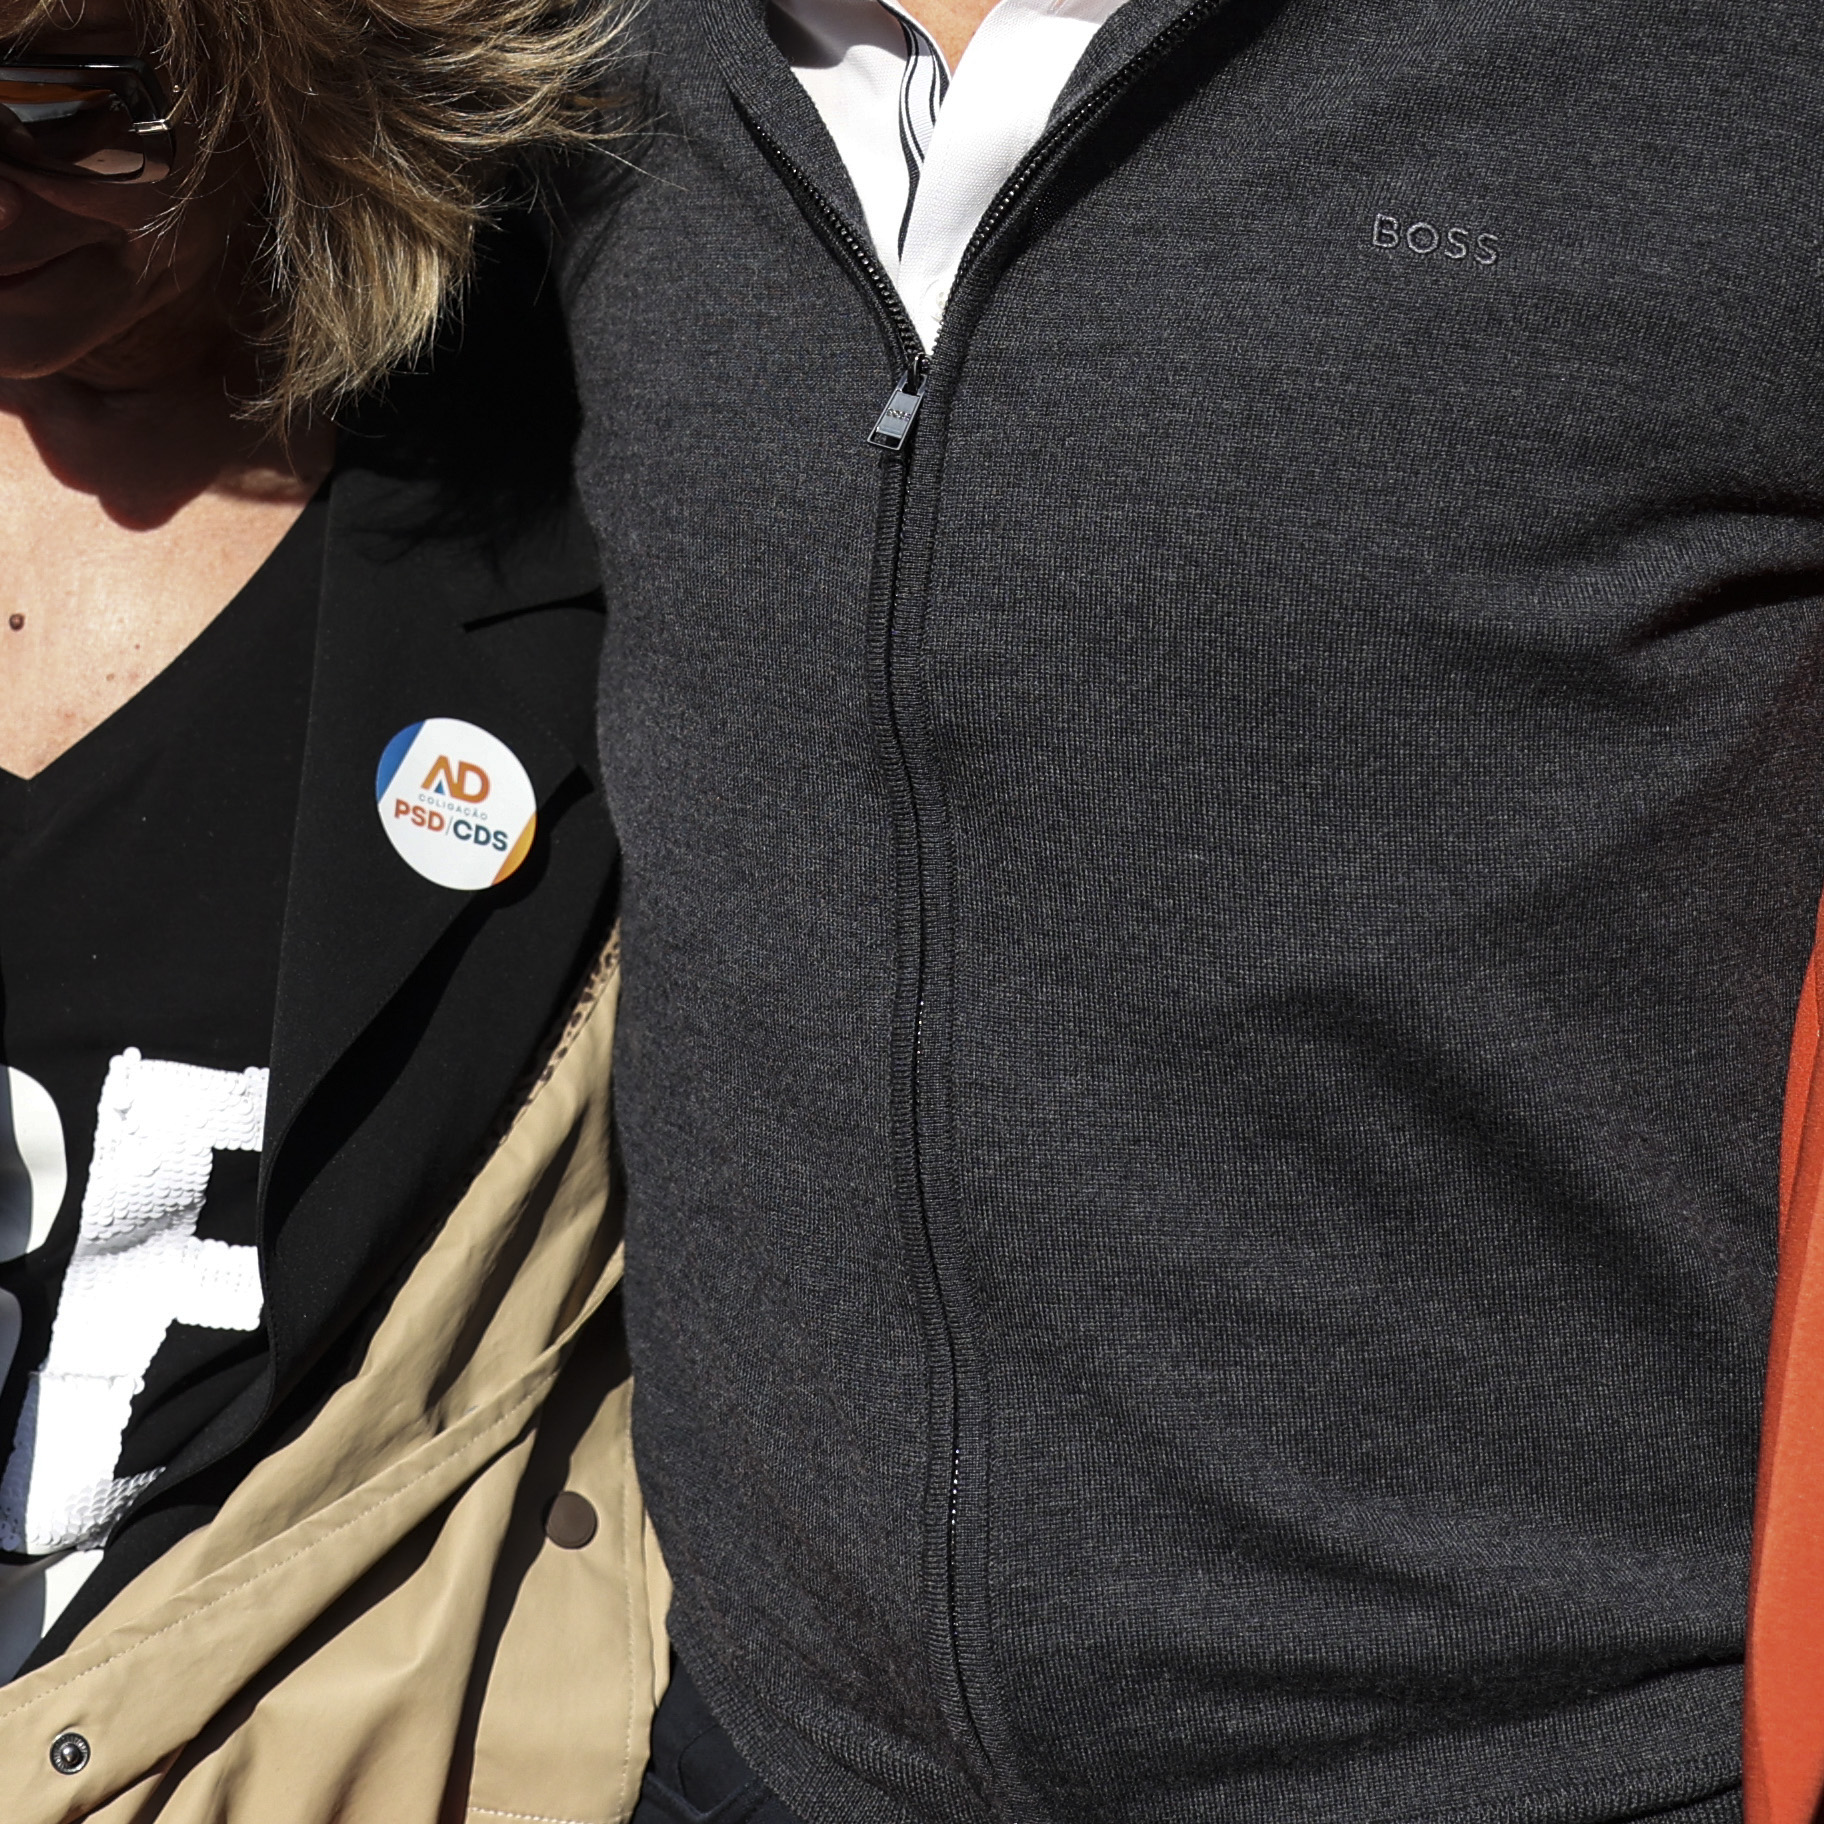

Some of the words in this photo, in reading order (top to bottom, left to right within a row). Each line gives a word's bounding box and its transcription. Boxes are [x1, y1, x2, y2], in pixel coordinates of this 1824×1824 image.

[1373, 213, 1499, 265] BOSS
[420, 754, 491, 804] AD
[418, 793, 489, 821] COLIGAÇÃO
